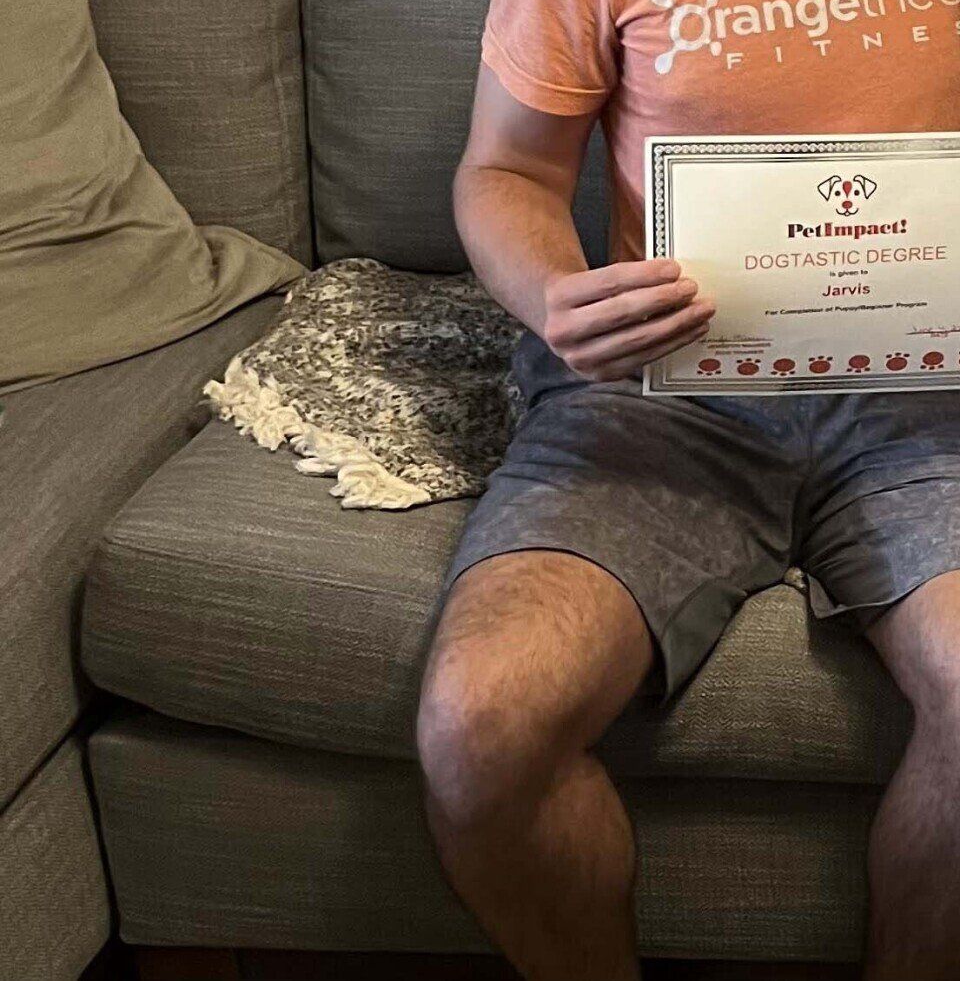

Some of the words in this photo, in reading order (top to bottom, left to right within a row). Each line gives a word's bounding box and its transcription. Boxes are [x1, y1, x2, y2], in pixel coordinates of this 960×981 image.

[787, 219, 908, 240] PetImpact!
[744, 250, 860, 270] DOGTASTIC
[866, 245, 948, 264] DEGREE
[838, 269, 859, 278] given
[822, 282, 871, 297] Jarvis
